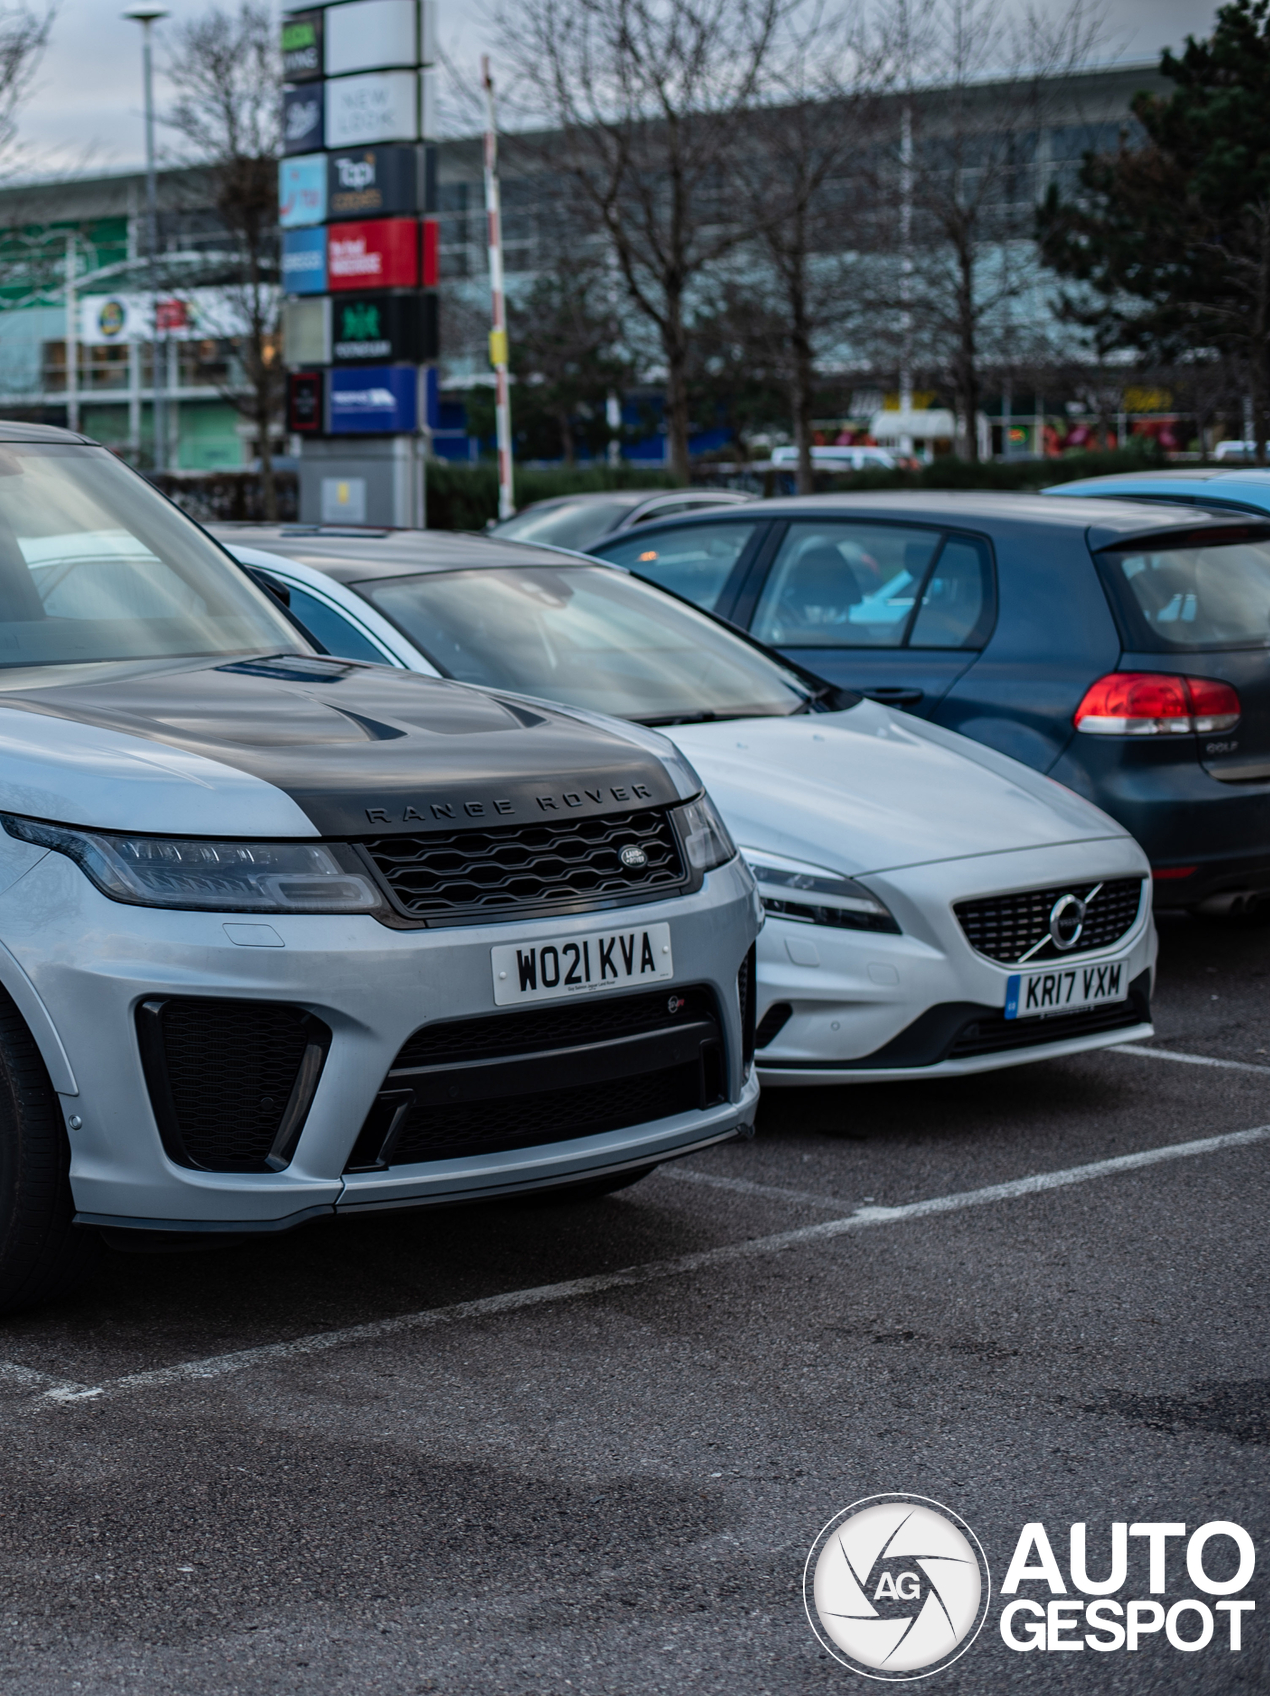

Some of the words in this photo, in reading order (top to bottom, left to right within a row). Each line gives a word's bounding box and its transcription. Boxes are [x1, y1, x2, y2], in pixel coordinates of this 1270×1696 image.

[341, 88, 390, 110] NEW
[337, 109, 397, 135] LOOK
[365, 800, 515, 824] RANGE
[536, 783, 653, 811] ROVER
[516, 940, 591, 992] WO21
[598, 931, 656, 980] KVA
[1026, 971, 1076, 1009] KR17
[1083, 963, 1122, 1000] VXM
